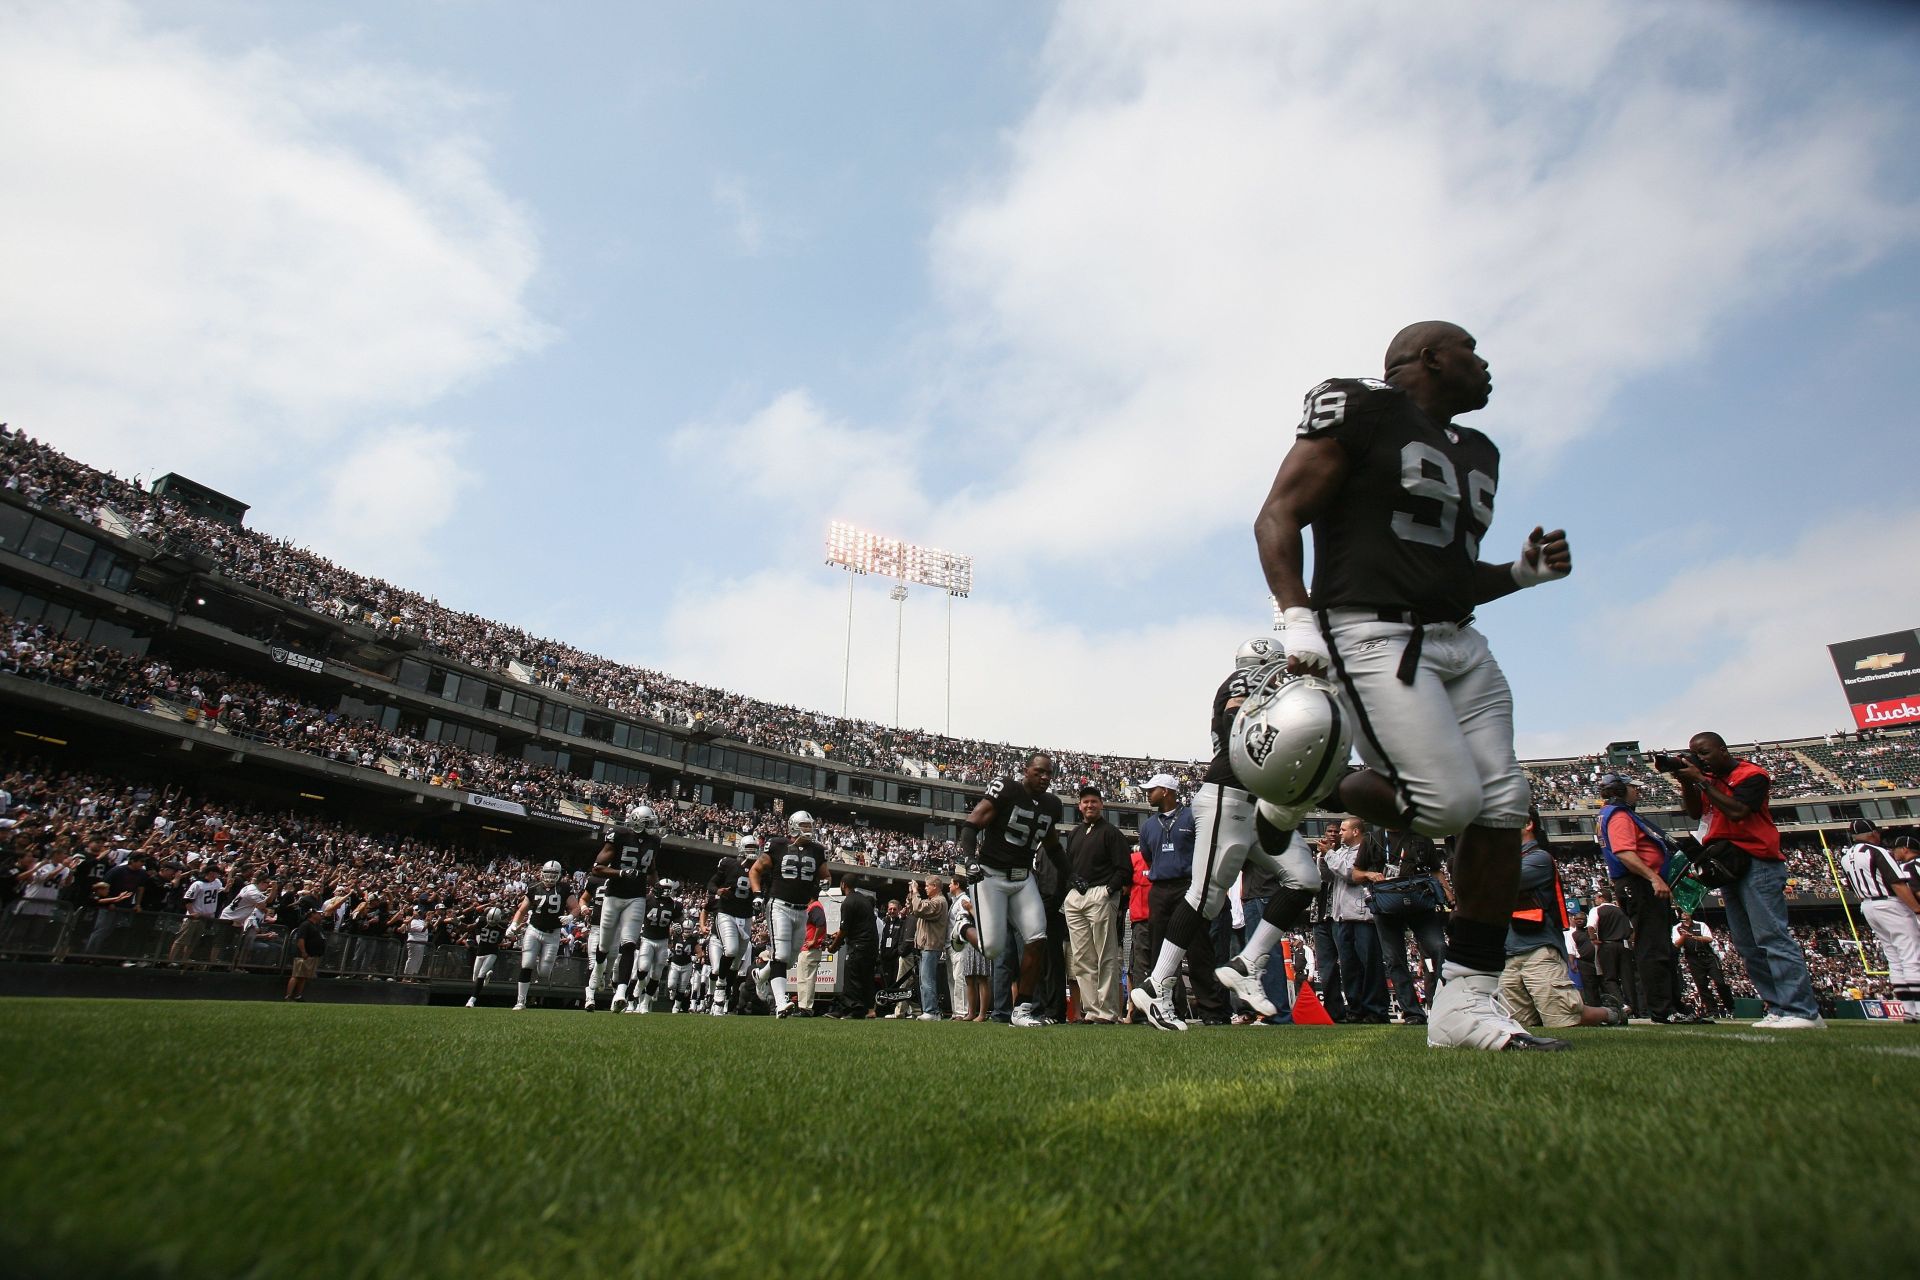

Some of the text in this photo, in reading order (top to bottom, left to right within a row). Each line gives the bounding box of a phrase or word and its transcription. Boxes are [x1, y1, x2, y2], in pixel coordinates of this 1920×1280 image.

[1390, 441, 1497, 566] 99
[1004, 804, 1053, 850] 52
[620, 845, 654, 874] 54
[780, 853, 817, 881] 62
[88, 864, 106, 878] 12
[203, 889, 218, 905] 24
[534, 894, 561, 914] 79
[646, 907, 673, 928] 46
[480, 927, 500, 944] 28
[675, 943, 692, 956] 64
